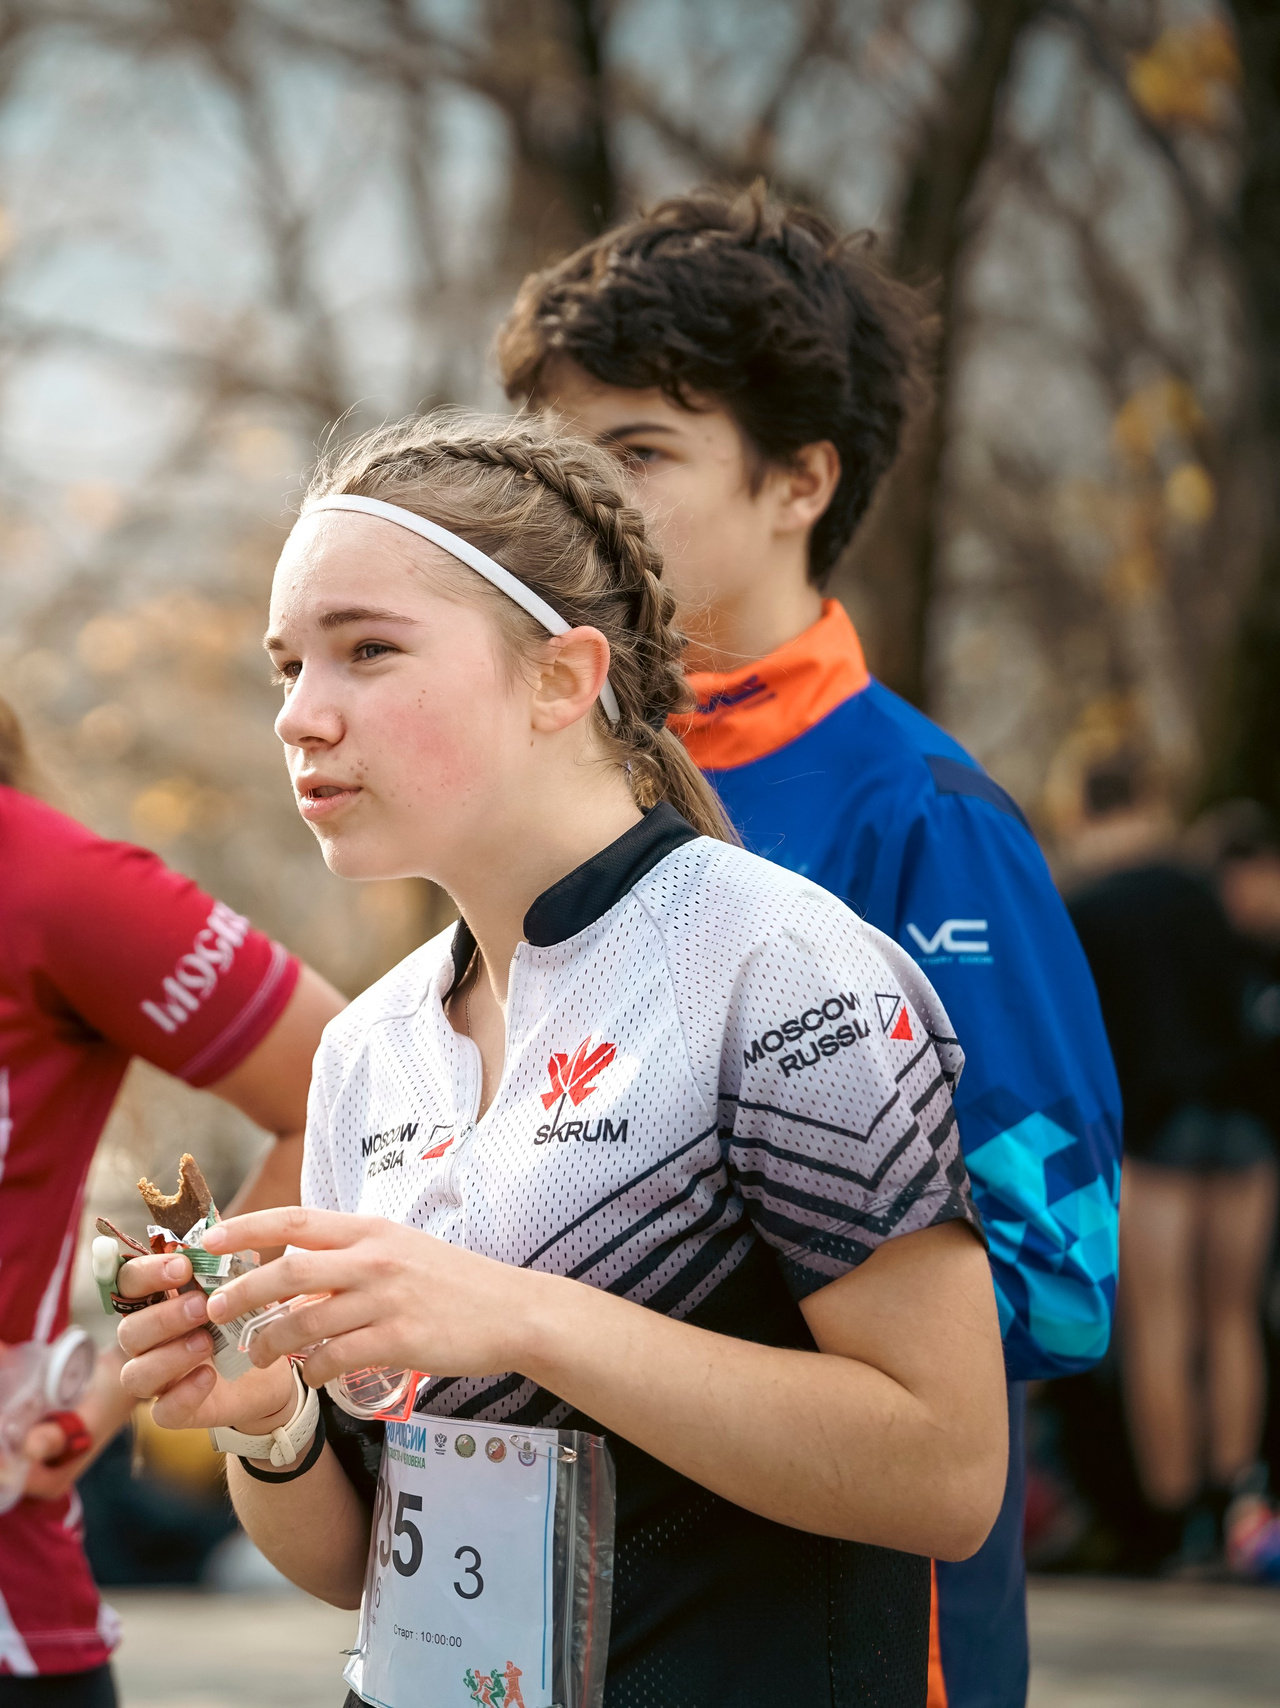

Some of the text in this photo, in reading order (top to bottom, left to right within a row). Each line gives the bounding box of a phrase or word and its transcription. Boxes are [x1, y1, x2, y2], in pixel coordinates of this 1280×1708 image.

[906, 918, 990, 954] VC
[743, 991, 862, 1069] MOSCOW
[362, 1122, 419, 1158] MOSCOW
[533, 1117, 629, 1146] SKRUM
[453, 1545, 485, 1600] 3
[393, 1624, 413, 1640] Старт
[420, 1631, 463, 1648] 10:00:00
